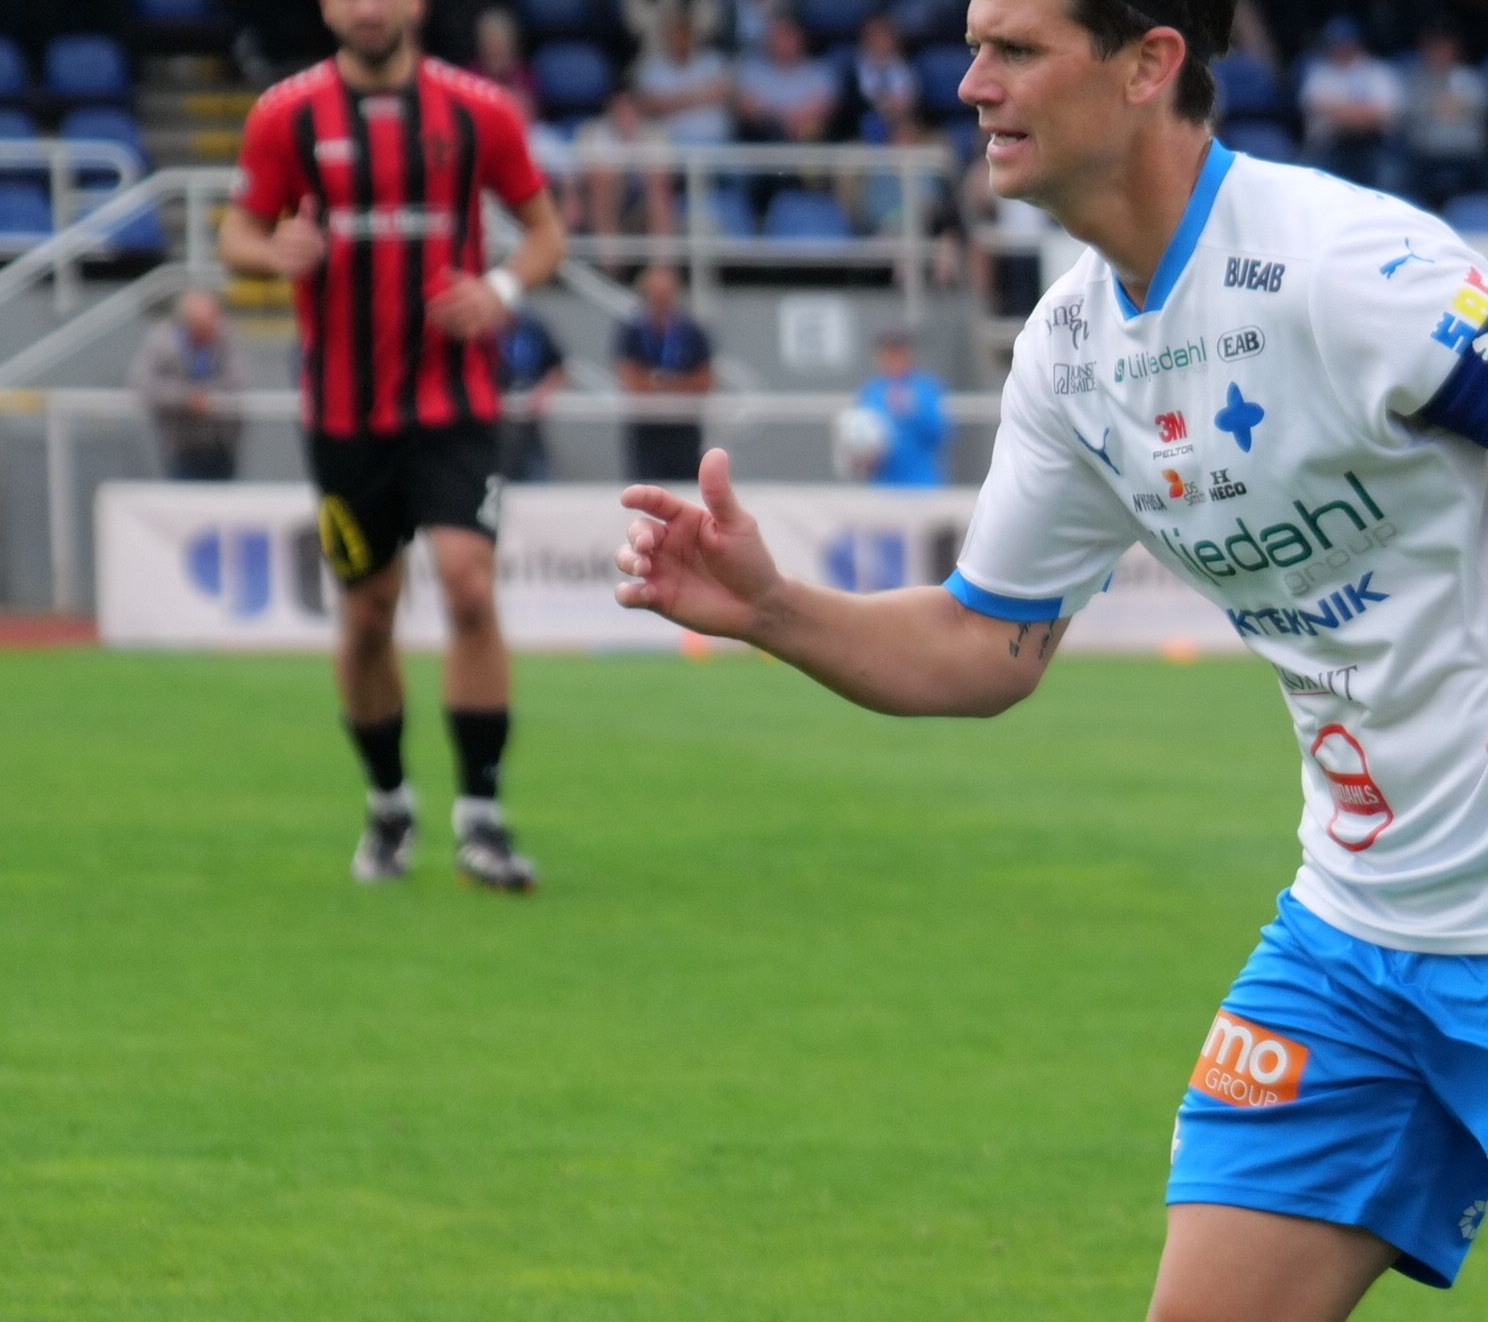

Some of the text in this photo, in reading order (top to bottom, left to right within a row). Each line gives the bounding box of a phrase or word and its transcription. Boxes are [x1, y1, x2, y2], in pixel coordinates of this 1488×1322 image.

[1223, 330, 1260, 358] EAB
[1154, 410, 1188, 443] 3M
[1152, 443, 1194, 461] PELTOR
[1208, 481, 1248, 502] HECO
[1226, 570, 1391, 638] KTEKNIK
[1205, 1067, 1279, 1107] GROUP
